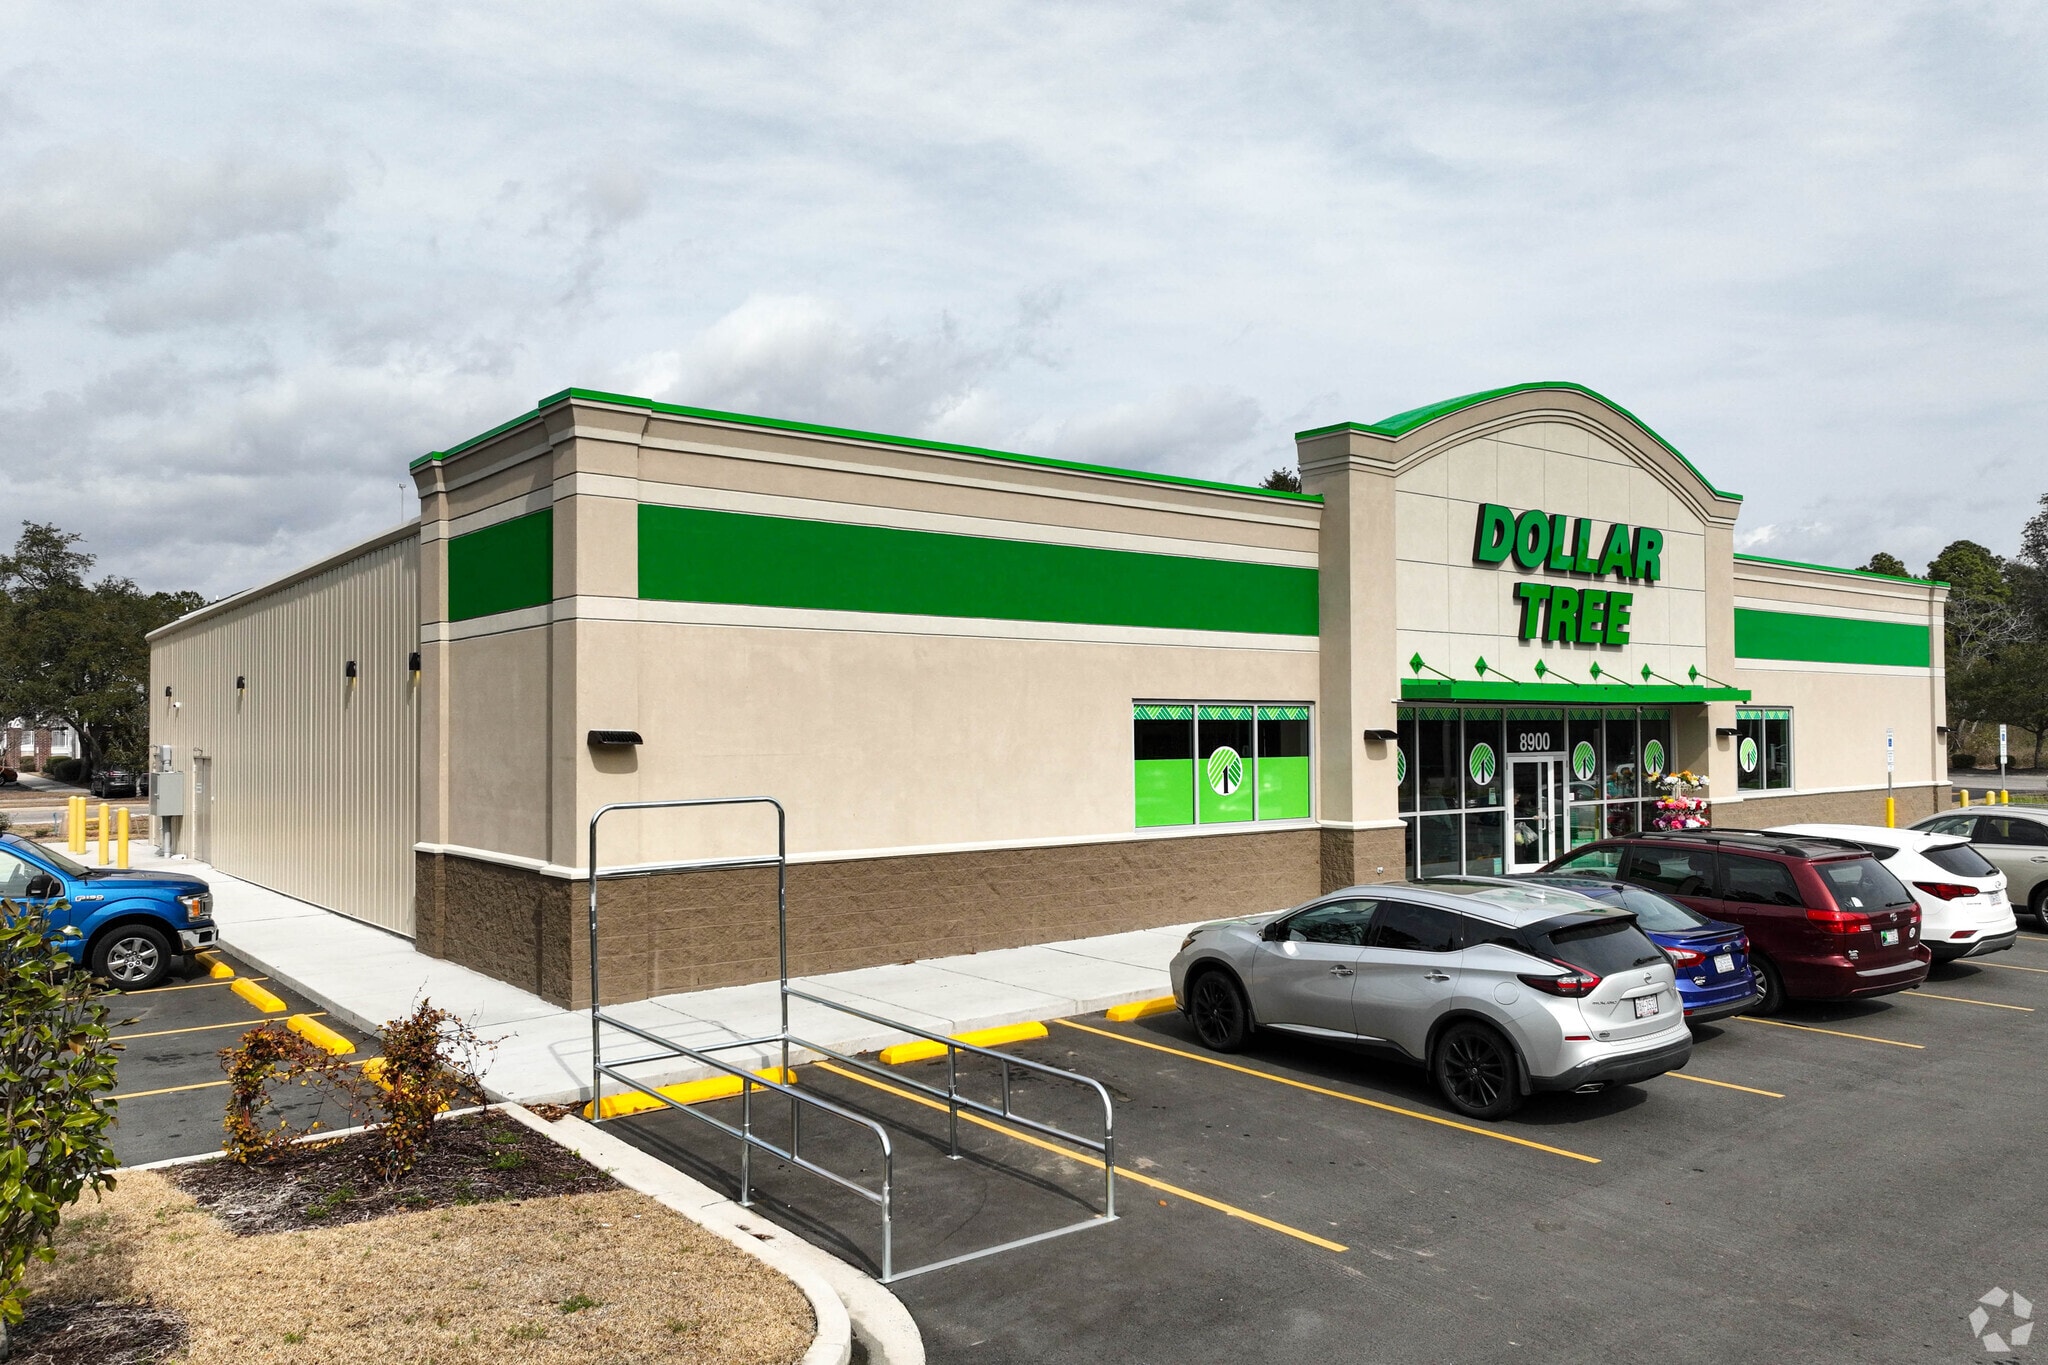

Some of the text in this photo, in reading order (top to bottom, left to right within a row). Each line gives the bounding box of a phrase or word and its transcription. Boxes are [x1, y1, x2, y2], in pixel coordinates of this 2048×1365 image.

[1473, 503, 1664, 581] DOLLAR
[1513, 582, 1633, 645] TREE
[1520, 732, 1550, 751] 8900
